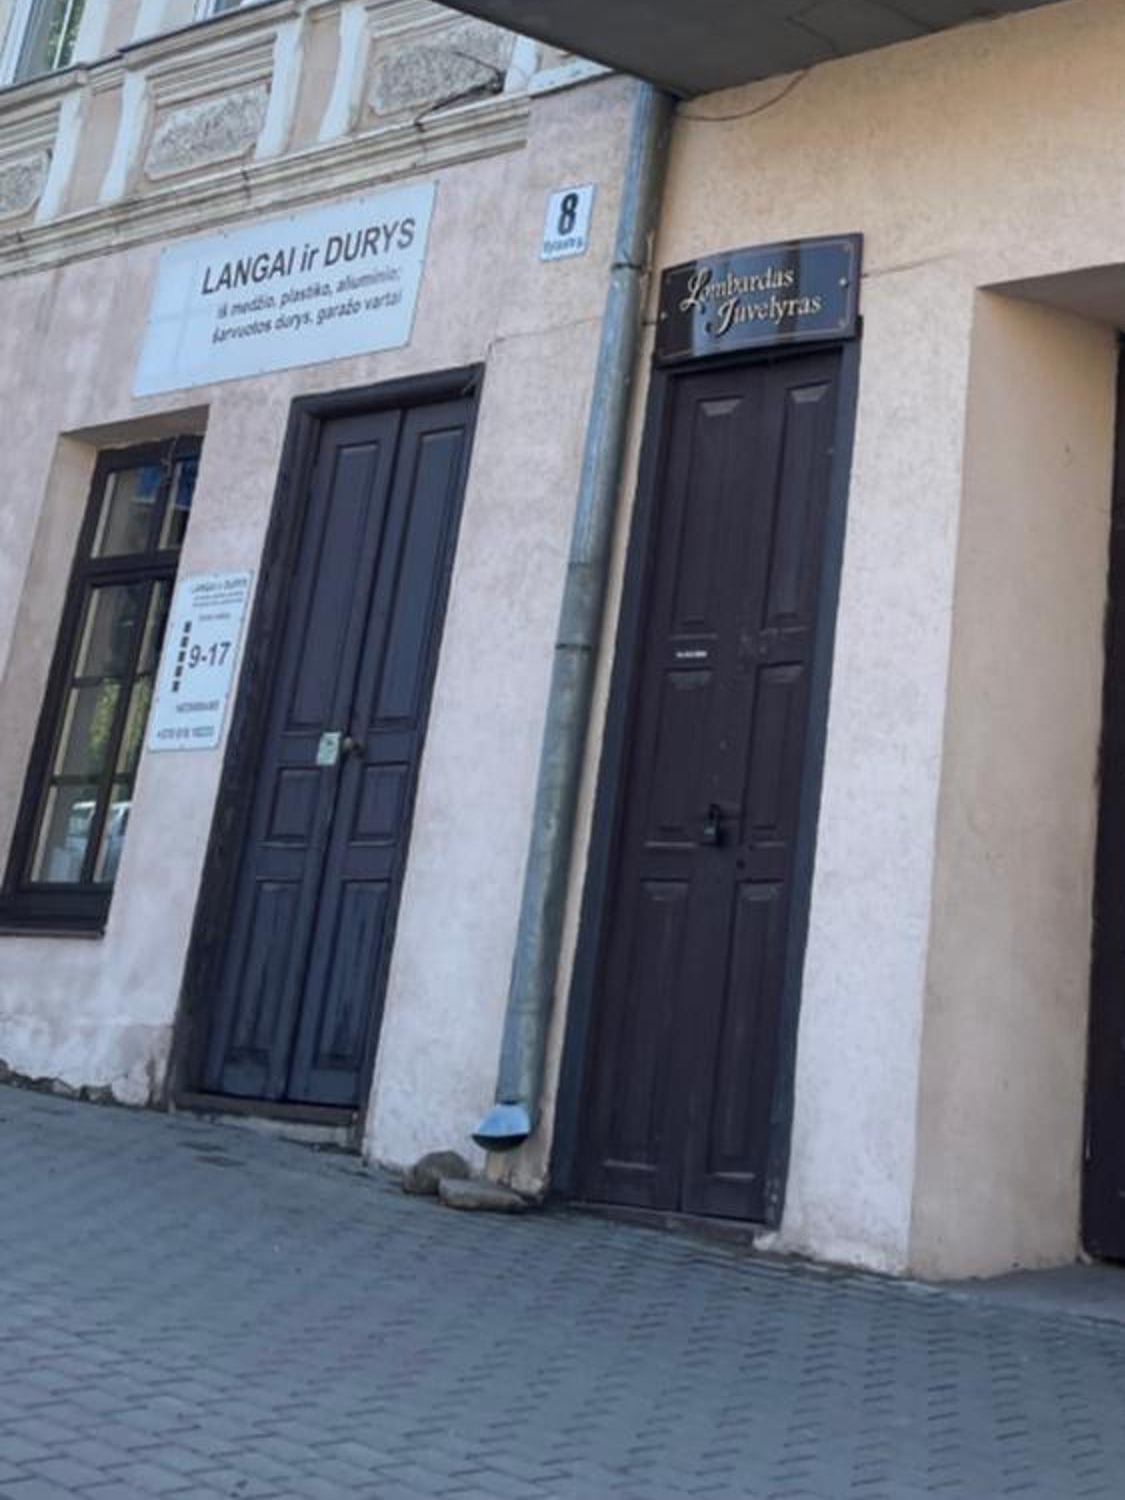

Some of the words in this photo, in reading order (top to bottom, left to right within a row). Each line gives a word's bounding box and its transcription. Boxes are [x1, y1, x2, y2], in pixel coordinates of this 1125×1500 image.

[558, 192, 578, 236] 8
[201, 247, 296, 295] LANGAI
[300, 244, 319, 272] ir
[324, 217, 416, 267] DURYS
[680, 267, 794, 311] Lombardas
[706, 295, 822, 336] Juvelyras
[188, 640, 231, 668] 9-17
